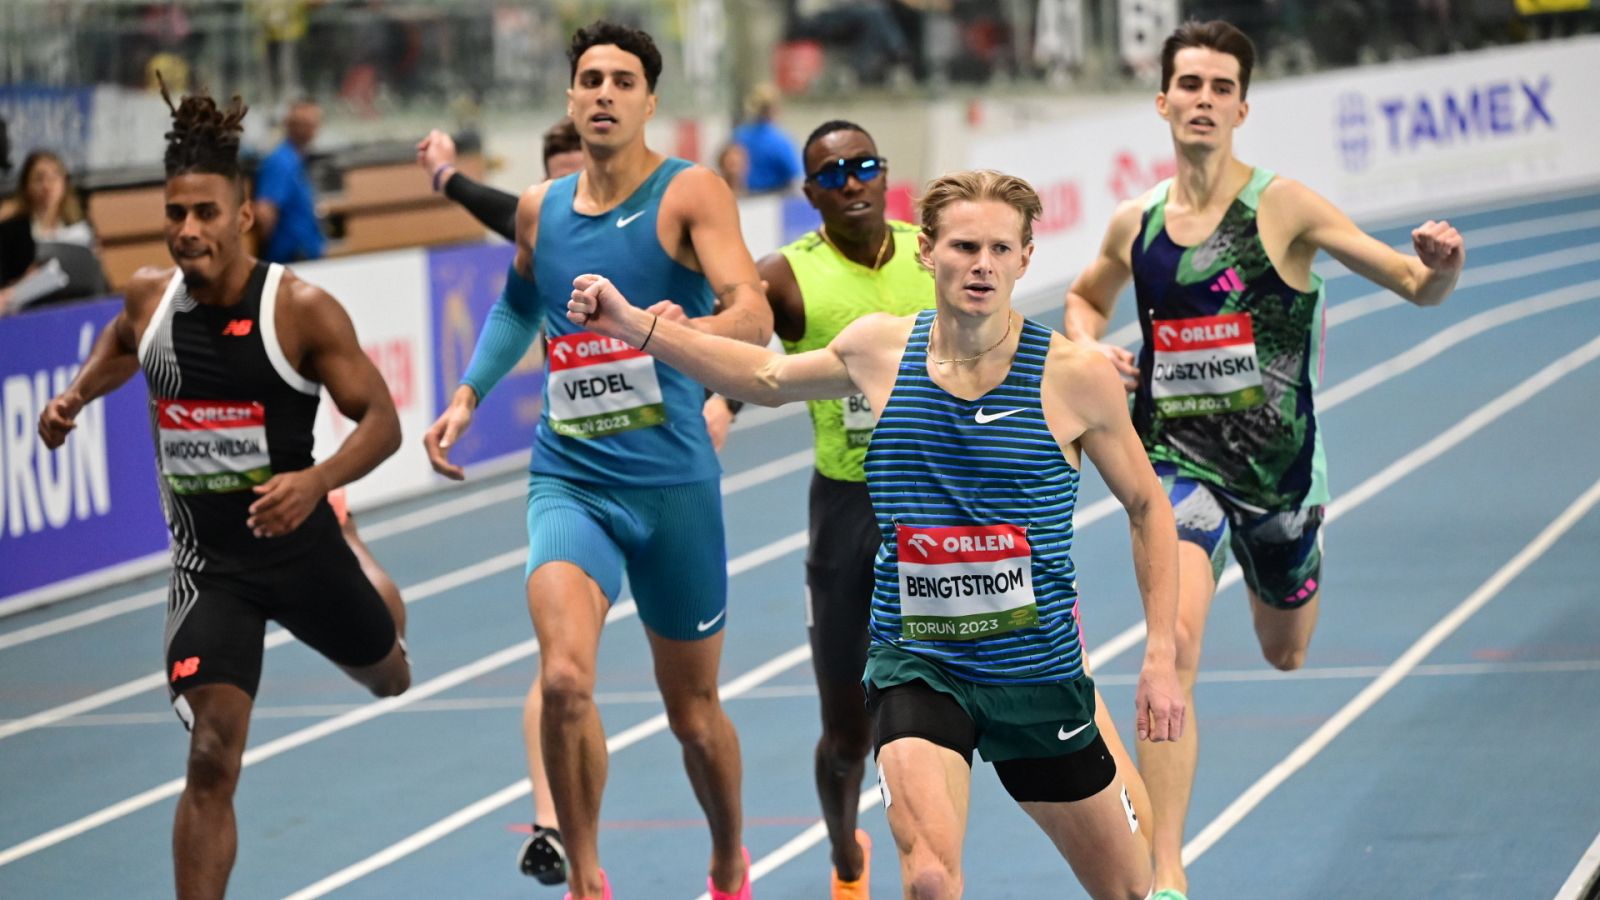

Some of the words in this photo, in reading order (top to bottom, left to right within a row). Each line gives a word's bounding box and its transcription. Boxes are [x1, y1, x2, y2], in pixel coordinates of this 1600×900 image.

[1379, 73, 1555, 150] TAMEX
[1180, 322, 1240, 343] ORLEN
[563, 372, 635, 401] VEDEL
[595, 414, 631, 432] 2023
[942, 533, 1015, 553] ORLEN
[906, 567, 1025, 599] BENGTSTROM
[906, 620, 956, 635] TORUŃ
[959, 619, 999, 635] 2023
